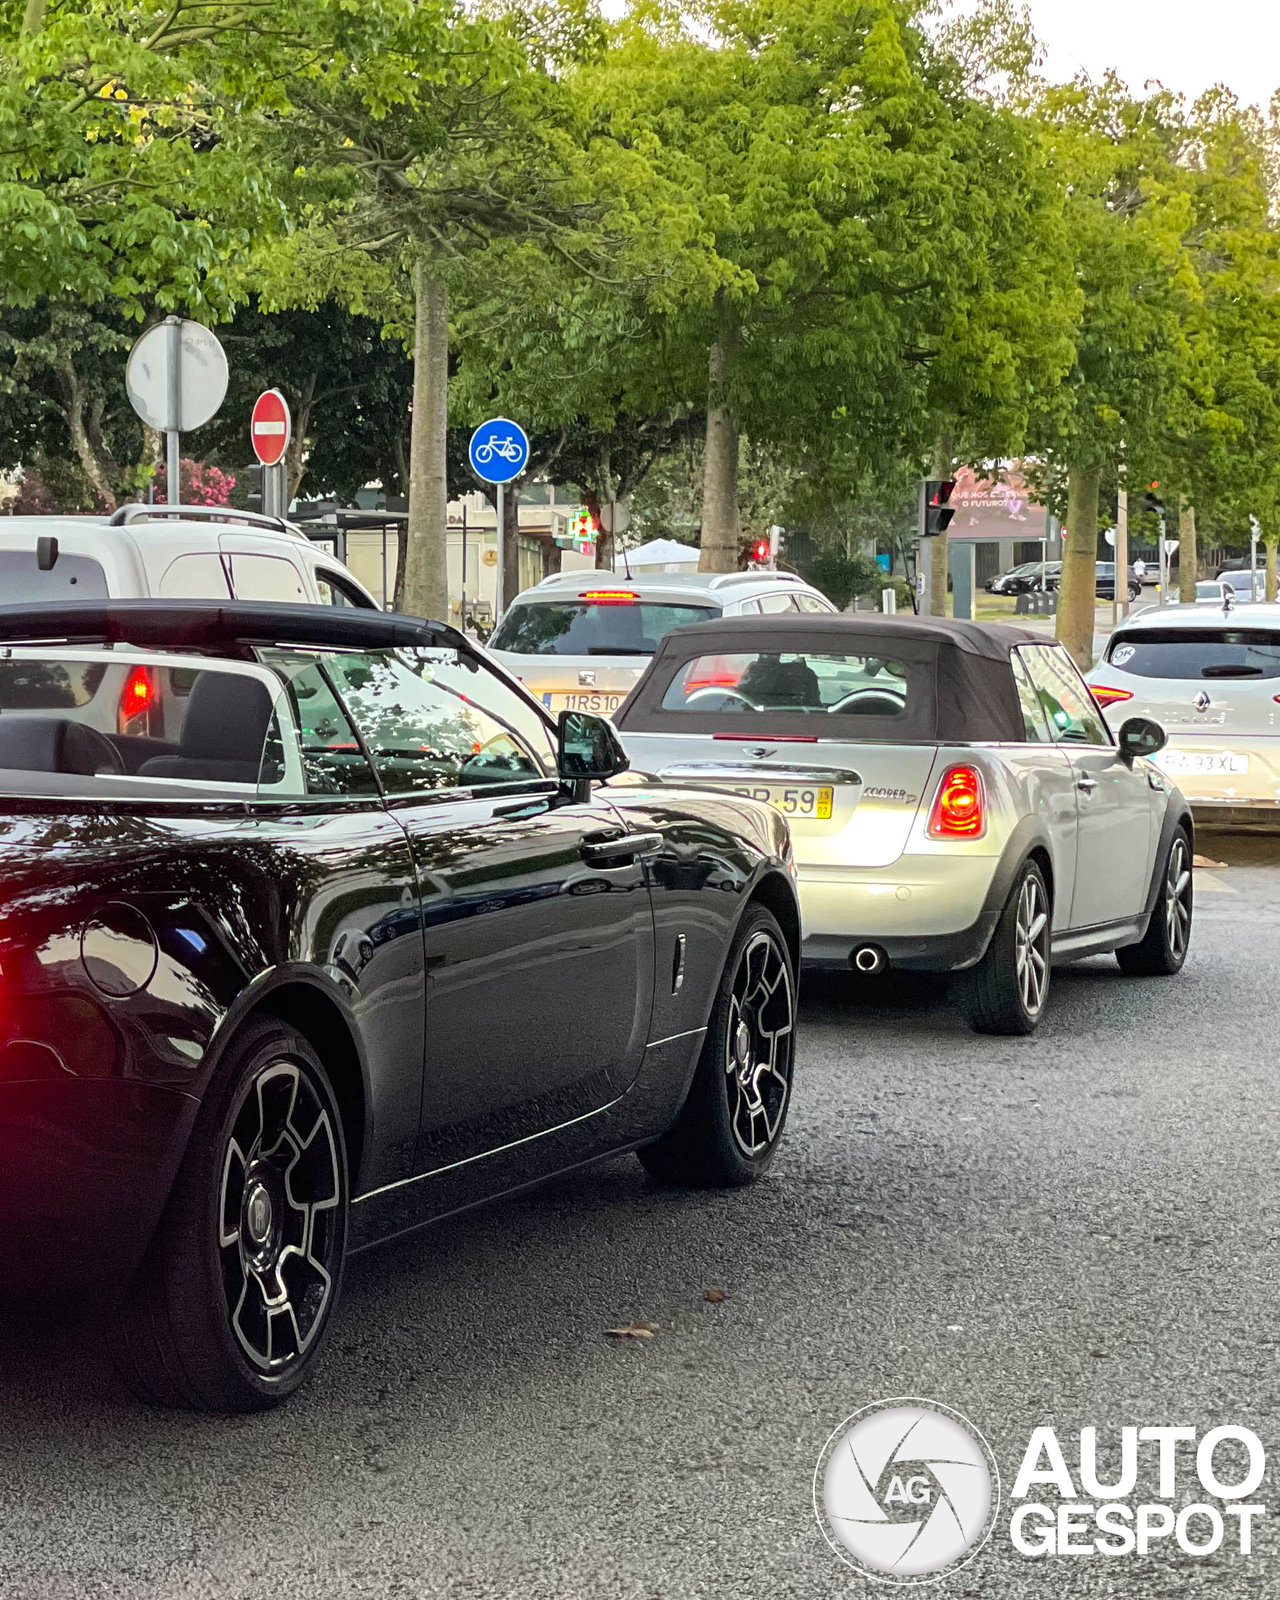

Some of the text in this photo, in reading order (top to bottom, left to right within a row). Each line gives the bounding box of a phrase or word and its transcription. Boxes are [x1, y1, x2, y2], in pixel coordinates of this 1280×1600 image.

[962, 500, 969, 508] O
[1114, 648, 1133, 659] OK
[819, 790, 829, 799] 15
[863, 787, 906, 800] COOPER
